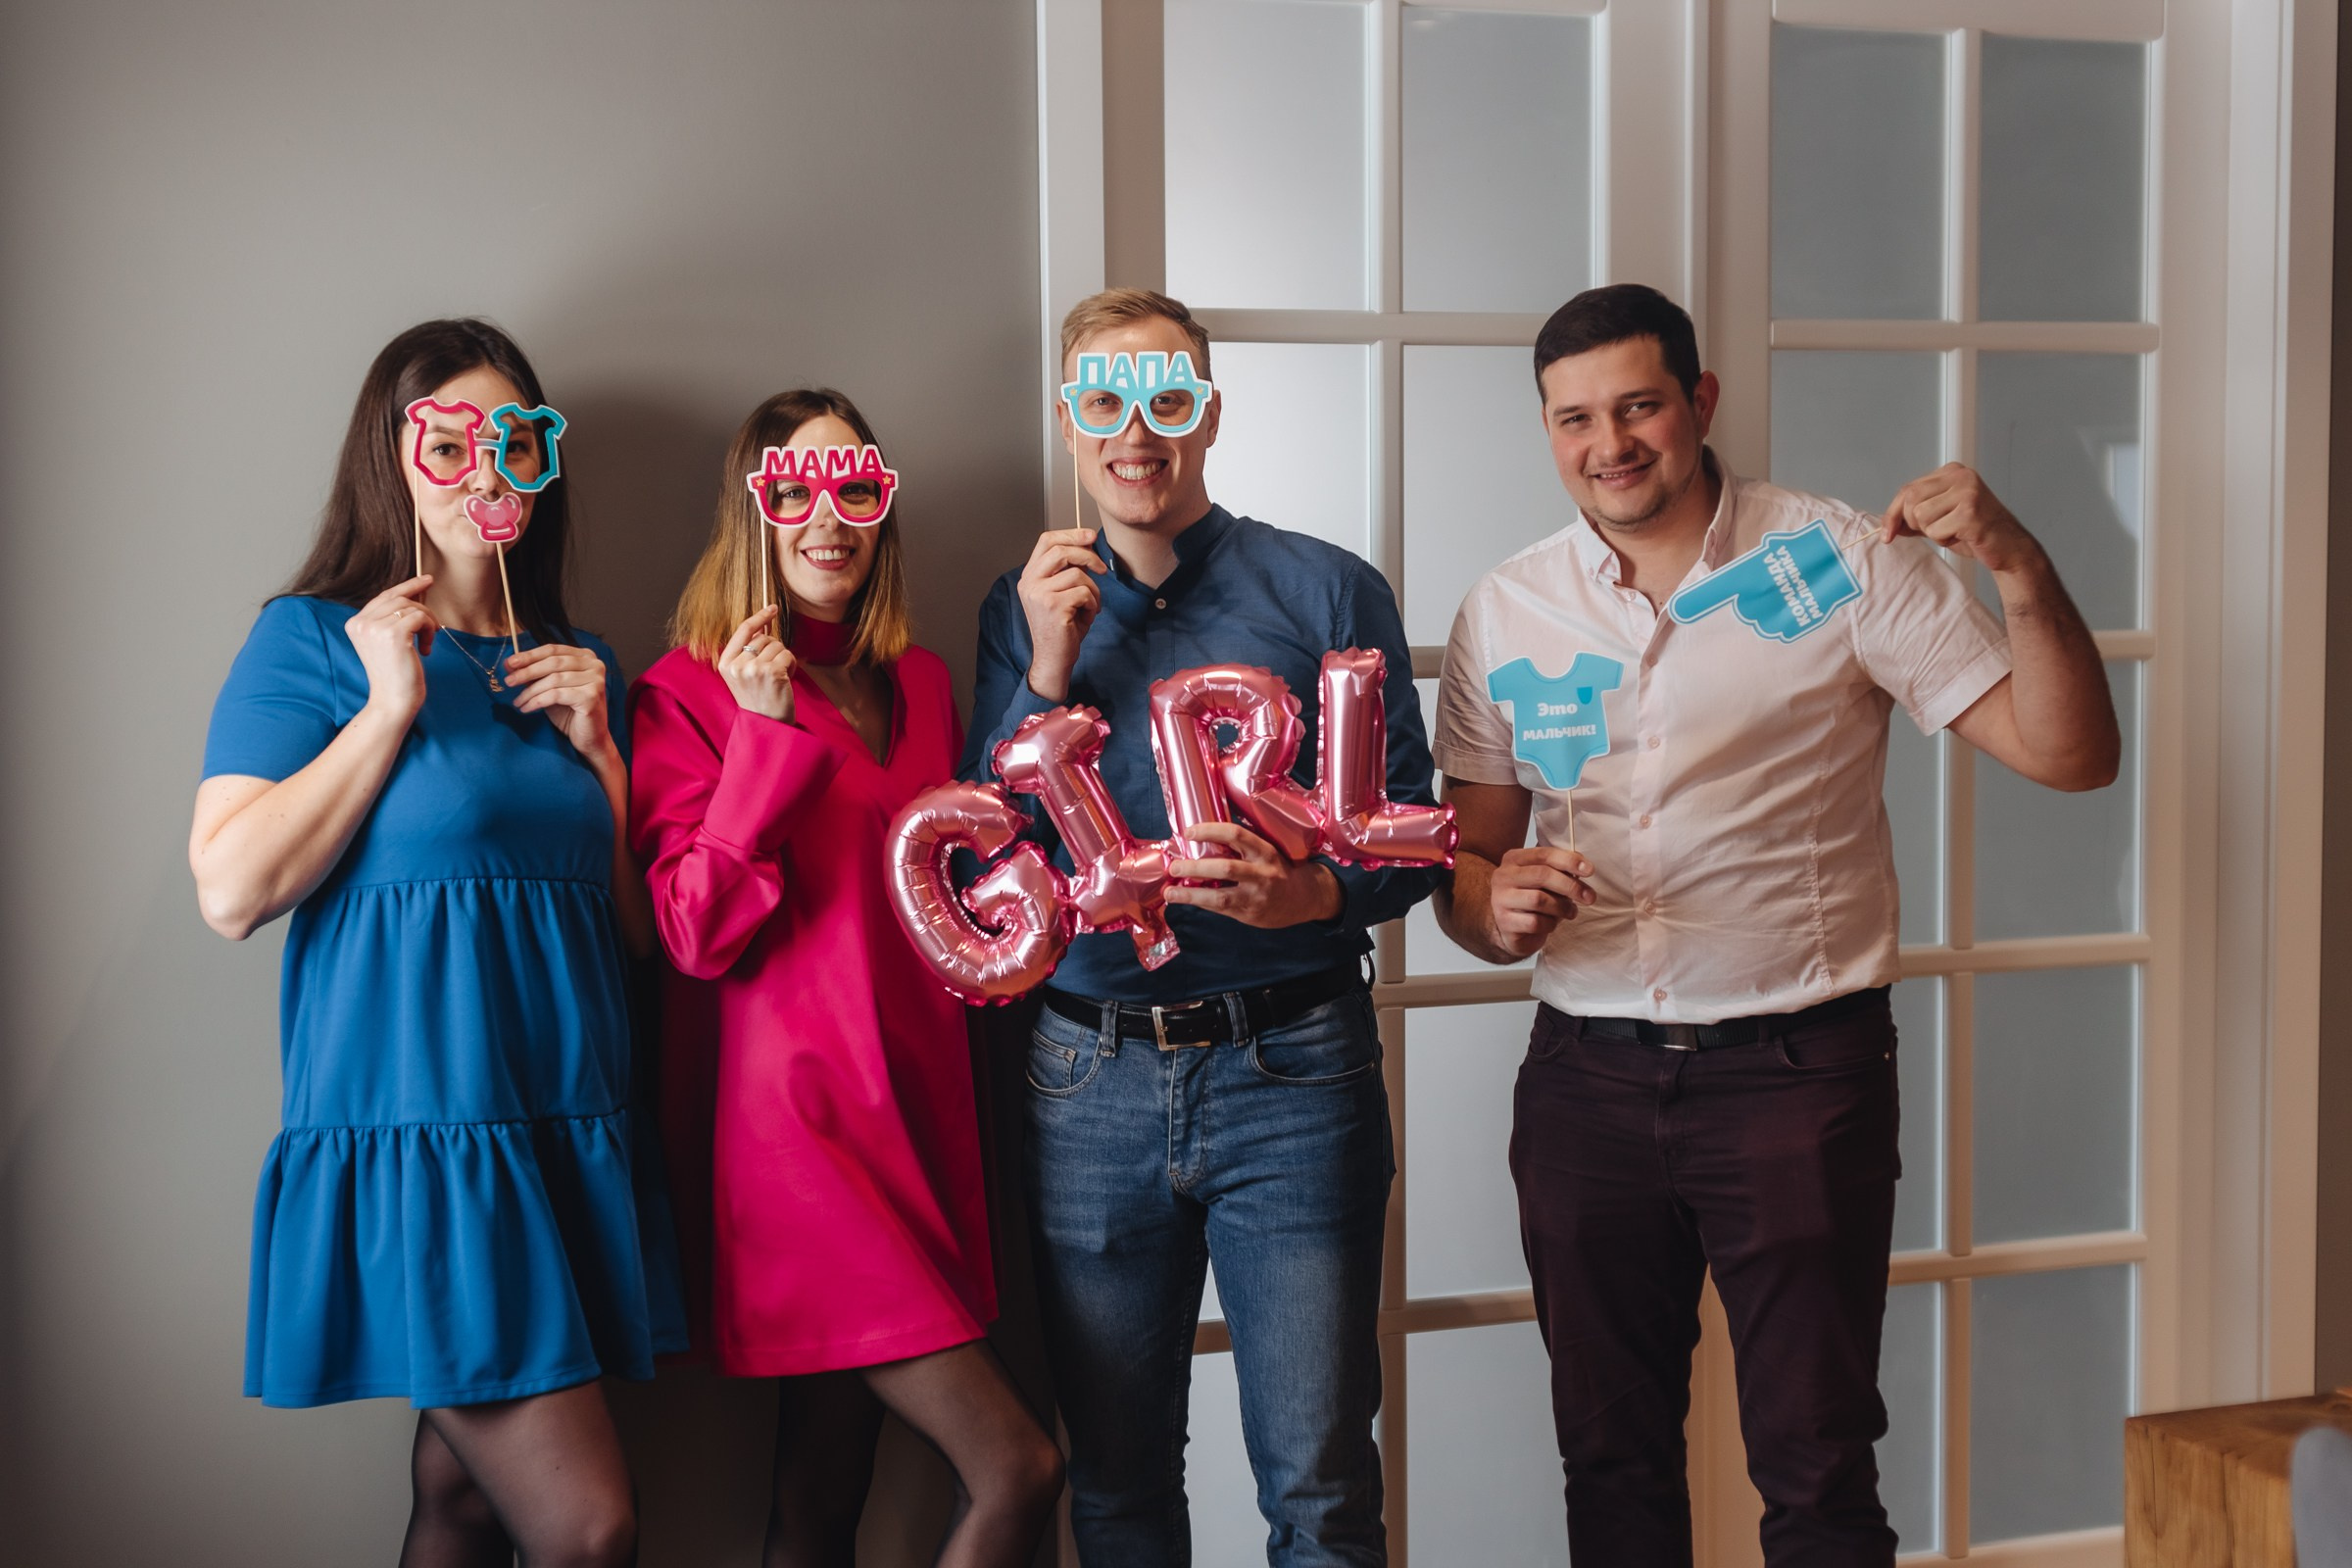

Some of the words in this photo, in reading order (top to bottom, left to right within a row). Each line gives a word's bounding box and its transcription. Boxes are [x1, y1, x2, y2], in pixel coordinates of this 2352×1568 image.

[1079, 353, 1197, 389] ПАПА
[765, 449, 883, 479] МАМА
[1763, 552, 1811, 627] КОМАНДА
[1776, 545, 1823, 619] МАЛЬЧИКА
[1537, 702, 1578, 716] Это
[1523, 724, 1596, 741] МАЛЬЧИК!
[885, 648, 1459, 1005] GIRL
